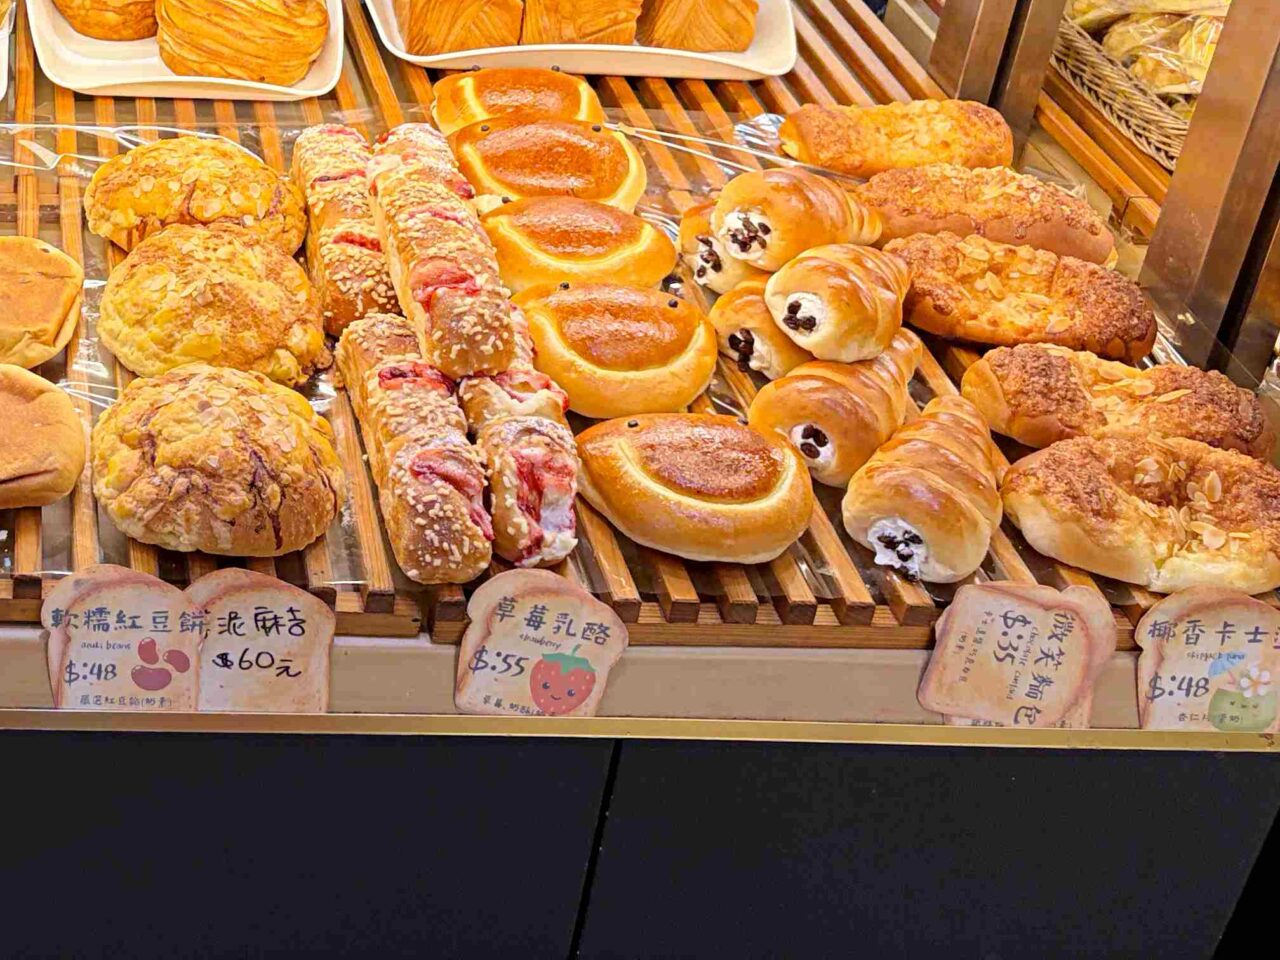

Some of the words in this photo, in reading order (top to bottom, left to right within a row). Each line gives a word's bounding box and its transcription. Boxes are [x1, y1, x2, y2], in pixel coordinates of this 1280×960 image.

[50, 607, 205, 635] 軟糯紅豆餅
[494, 595, 612, 646] 草莓乳酪
[1147, 619, 1280, 651] 椰香卡士
[1013, 610, 1077, 726] 微笑麵包
